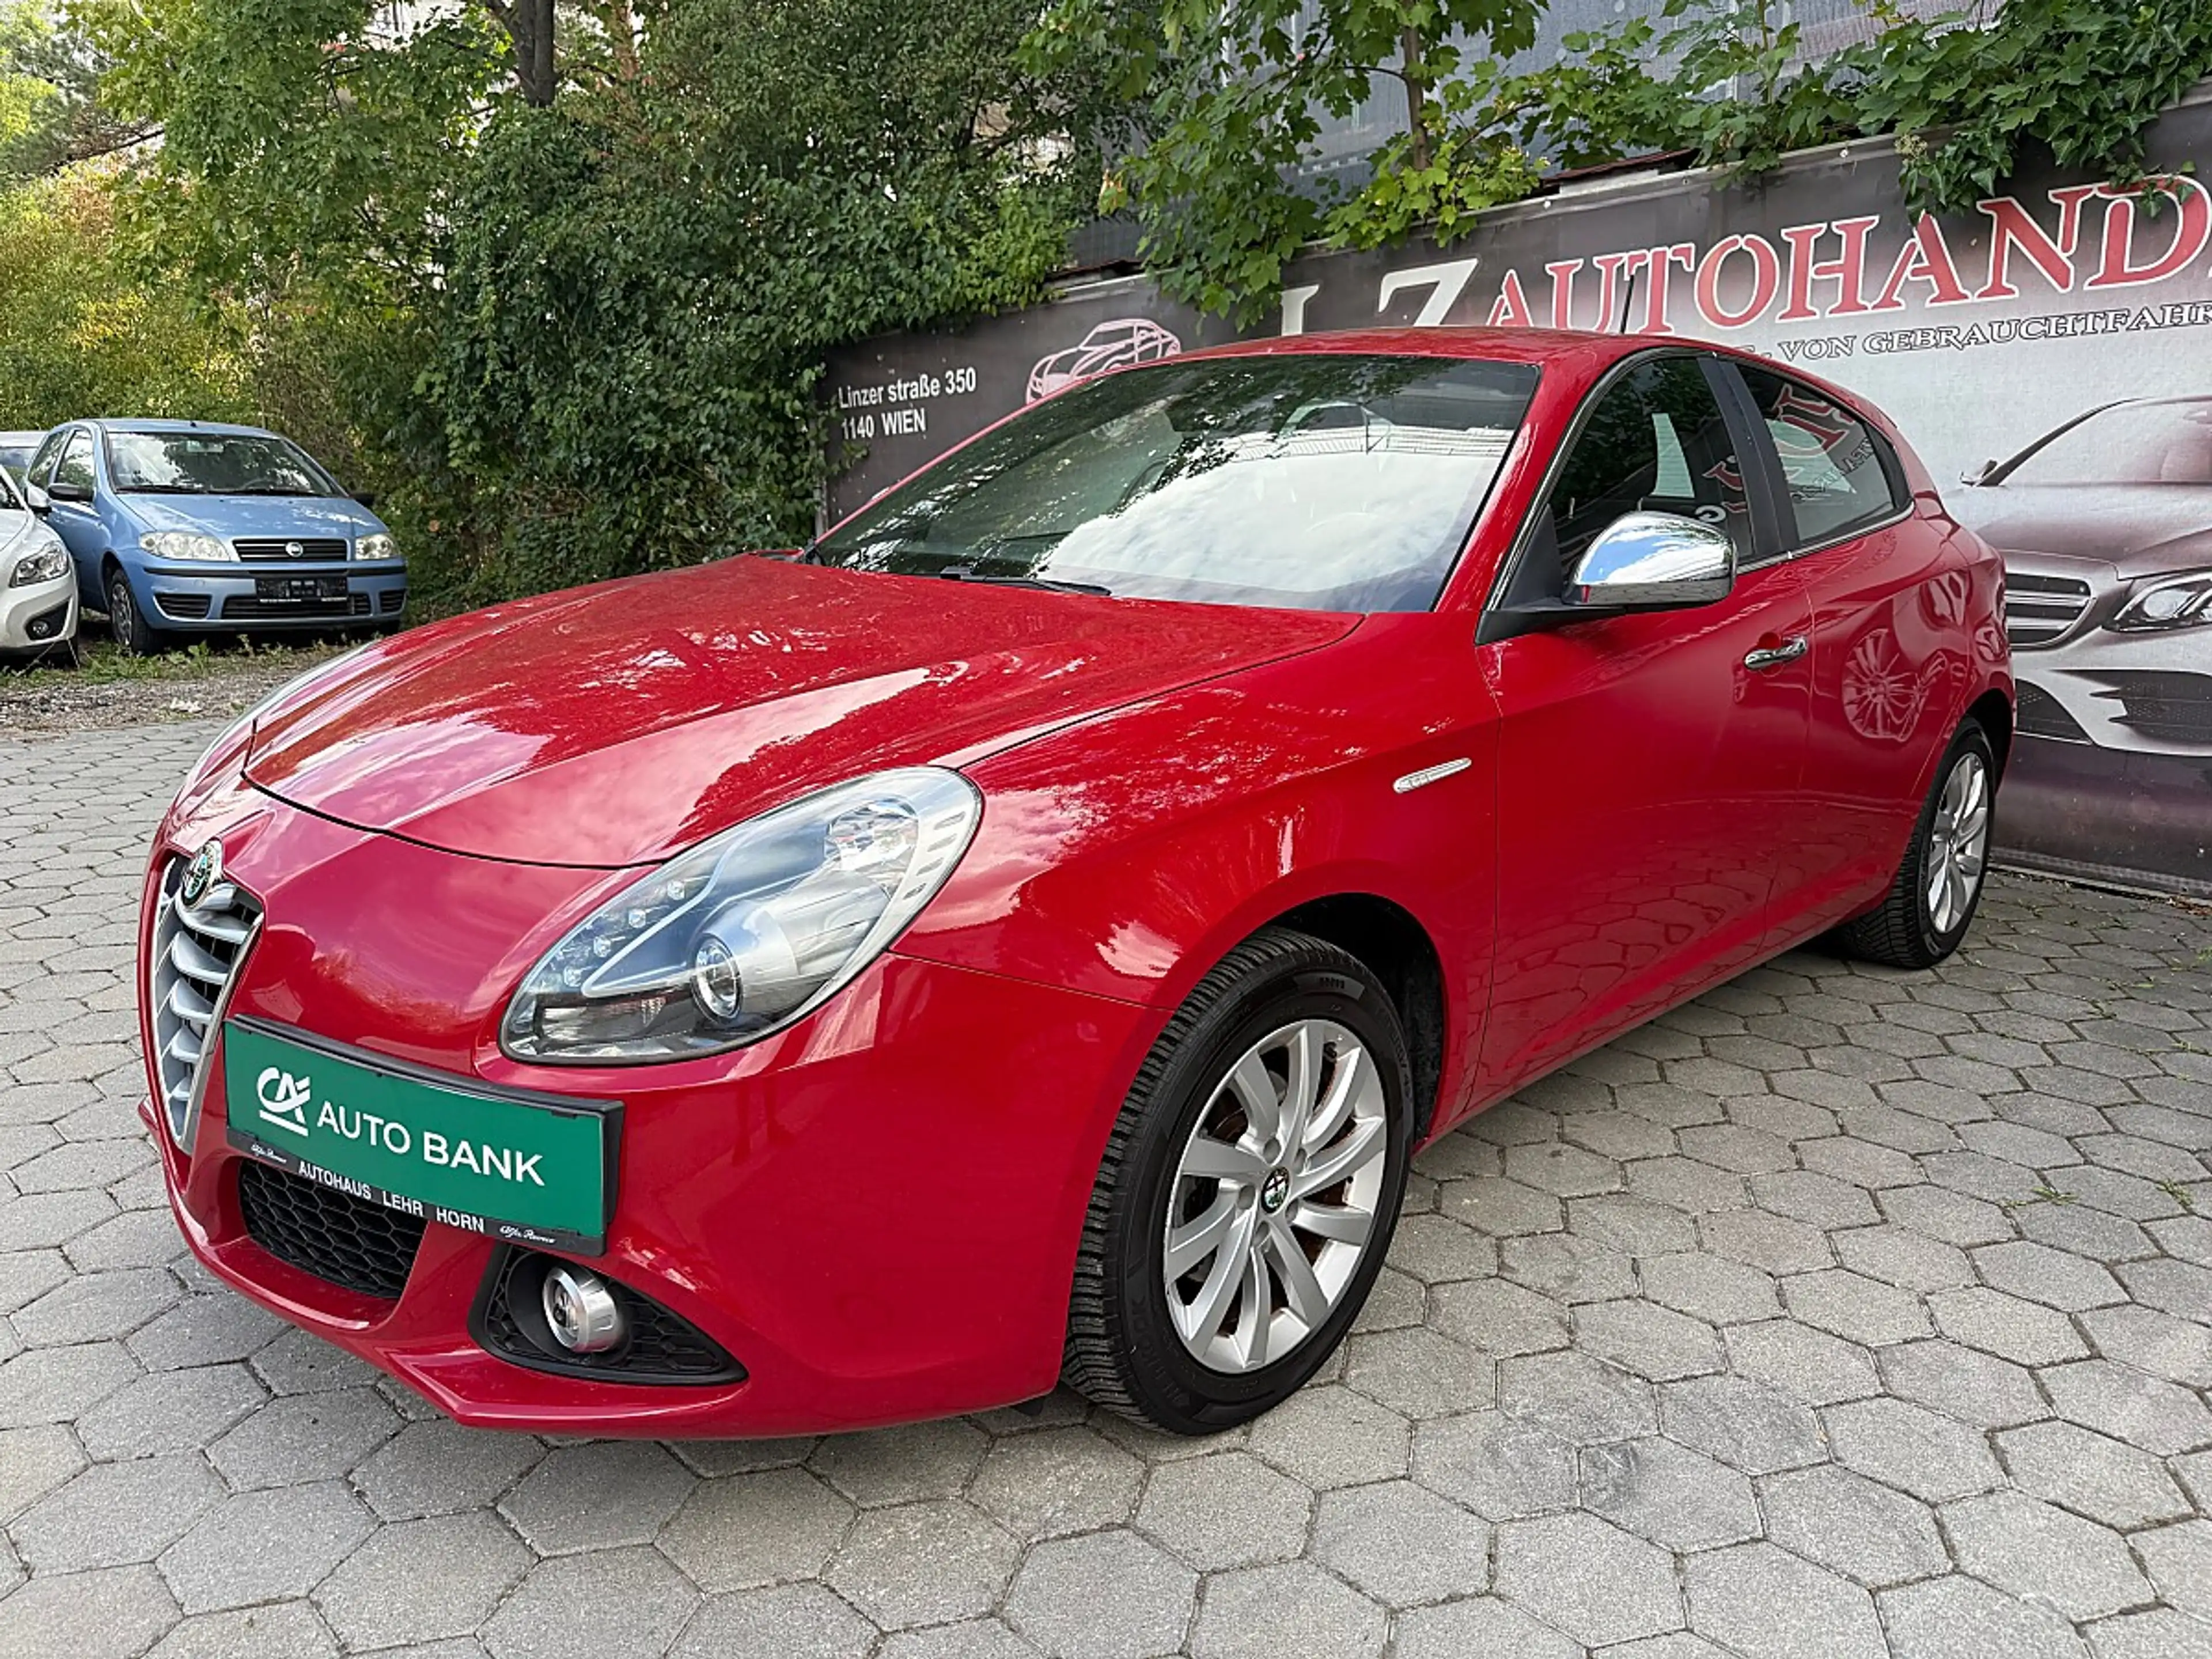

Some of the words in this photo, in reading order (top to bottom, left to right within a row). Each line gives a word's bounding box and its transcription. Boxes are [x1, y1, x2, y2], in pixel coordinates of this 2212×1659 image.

[1487, 173, 2212, 336] AUTOHAND
[1778, 335, 1856, 361] VON
[838, 385, 884, 408] Linzer
[888, 373, 941, 403] straße
[945, 366, 977, 395] 350
[841, 414, 875, 440] 1140
[881, 407, 926, 435] WIEN
[317, 1101, 411, 1154] AUTO
[423, 1131, 545, 1187] BANK
[298, 1160, 372, 1200] AUTOHAUS
[382, 1190, 423, 1217] LEHR
[436, 1207, 485, 1233] HORN
